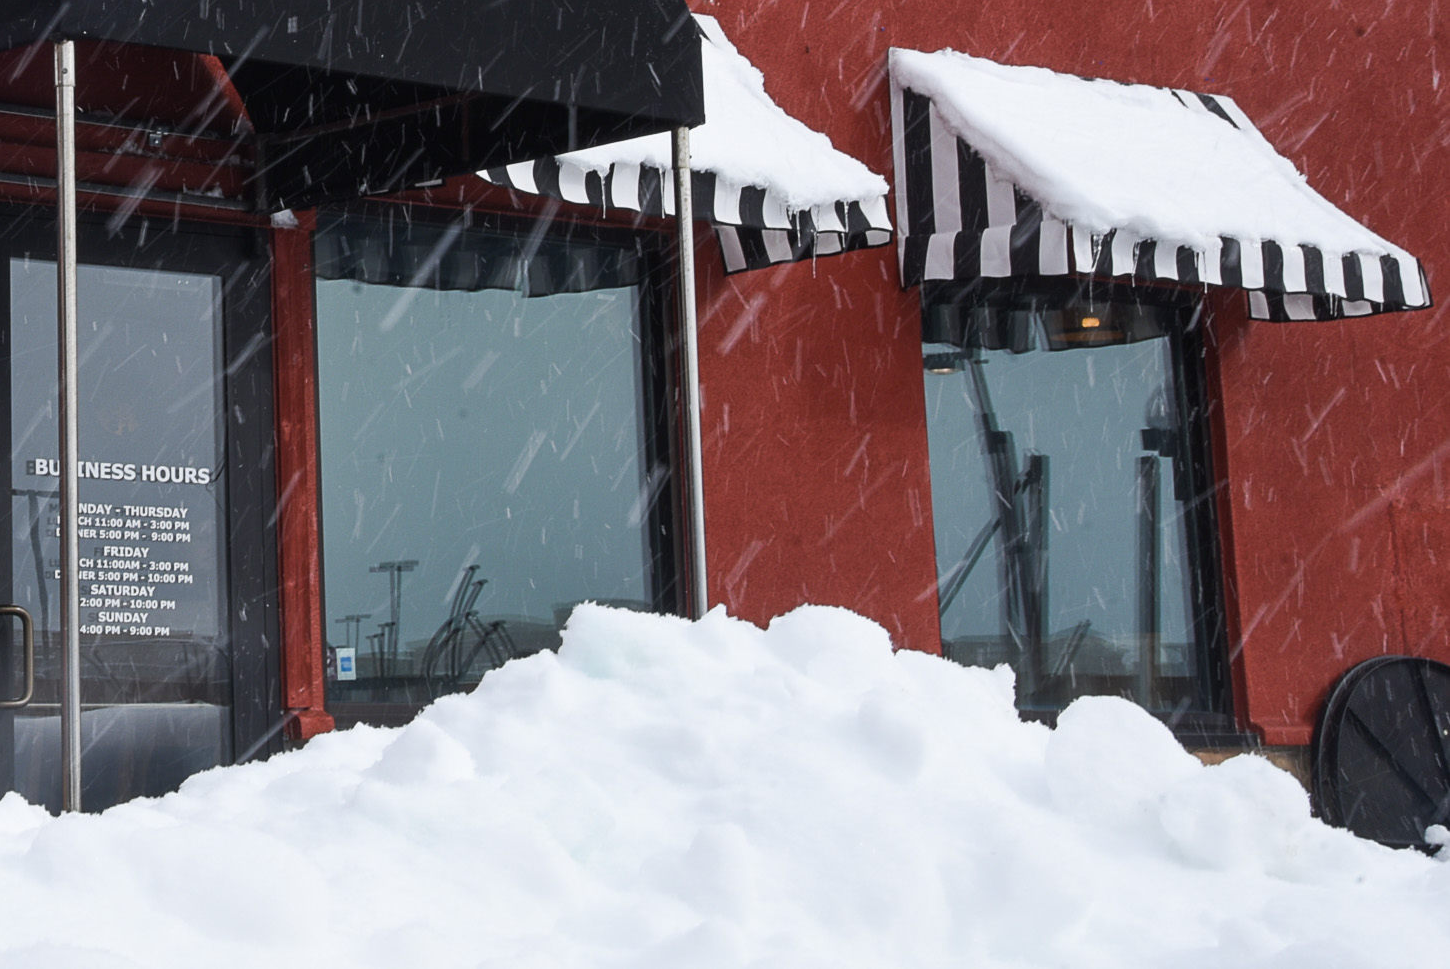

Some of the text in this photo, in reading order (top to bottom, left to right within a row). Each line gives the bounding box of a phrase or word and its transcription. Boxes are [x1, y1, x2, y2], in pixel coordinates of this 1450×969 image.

[35, 458, 211, 485] BUINESS HOURS
[123, 505, 189, 519] THURSDAY
[94, 518, 123, 528] 11:00
[125, 519, 141, 529] AM
[149, 520, 173, 530] 3:00
[174, 521, 190, 531] PM
[99, 530, 122, 539] 5:00
[124, 531, 139, 541] PM
[151, 532, 174, 542] 9:00
[175, 533, 191, 543] PM
[103, 546, 150, 558] FRIDAY
[96, 559, 140, 570] 11:00AM
[149, 561, 172, 571] 3:00
[173, 562, 189, 572] PM
[98, 571, 121, 581] 5:00
[122, 572, 139, 582] PM
[147, 573, 176, 583] 10:00
[177, 574, 193, 584] PM
[90, 584, 156, 597] SATURDAY
[79, 598, 103, 608] 2:00
[104, 598, 120, 608] PM
[130, 599, 158, 609] 10:00
[160, 600, 176, 610] PM
[98, 611, 149, 623] SUNDAY
[79, 625, 103, 634] 4:00
[104, 625, 121, 635] PM
[129, 626, 153, 636] 9:00
[154, 626, 170, 636] PM
